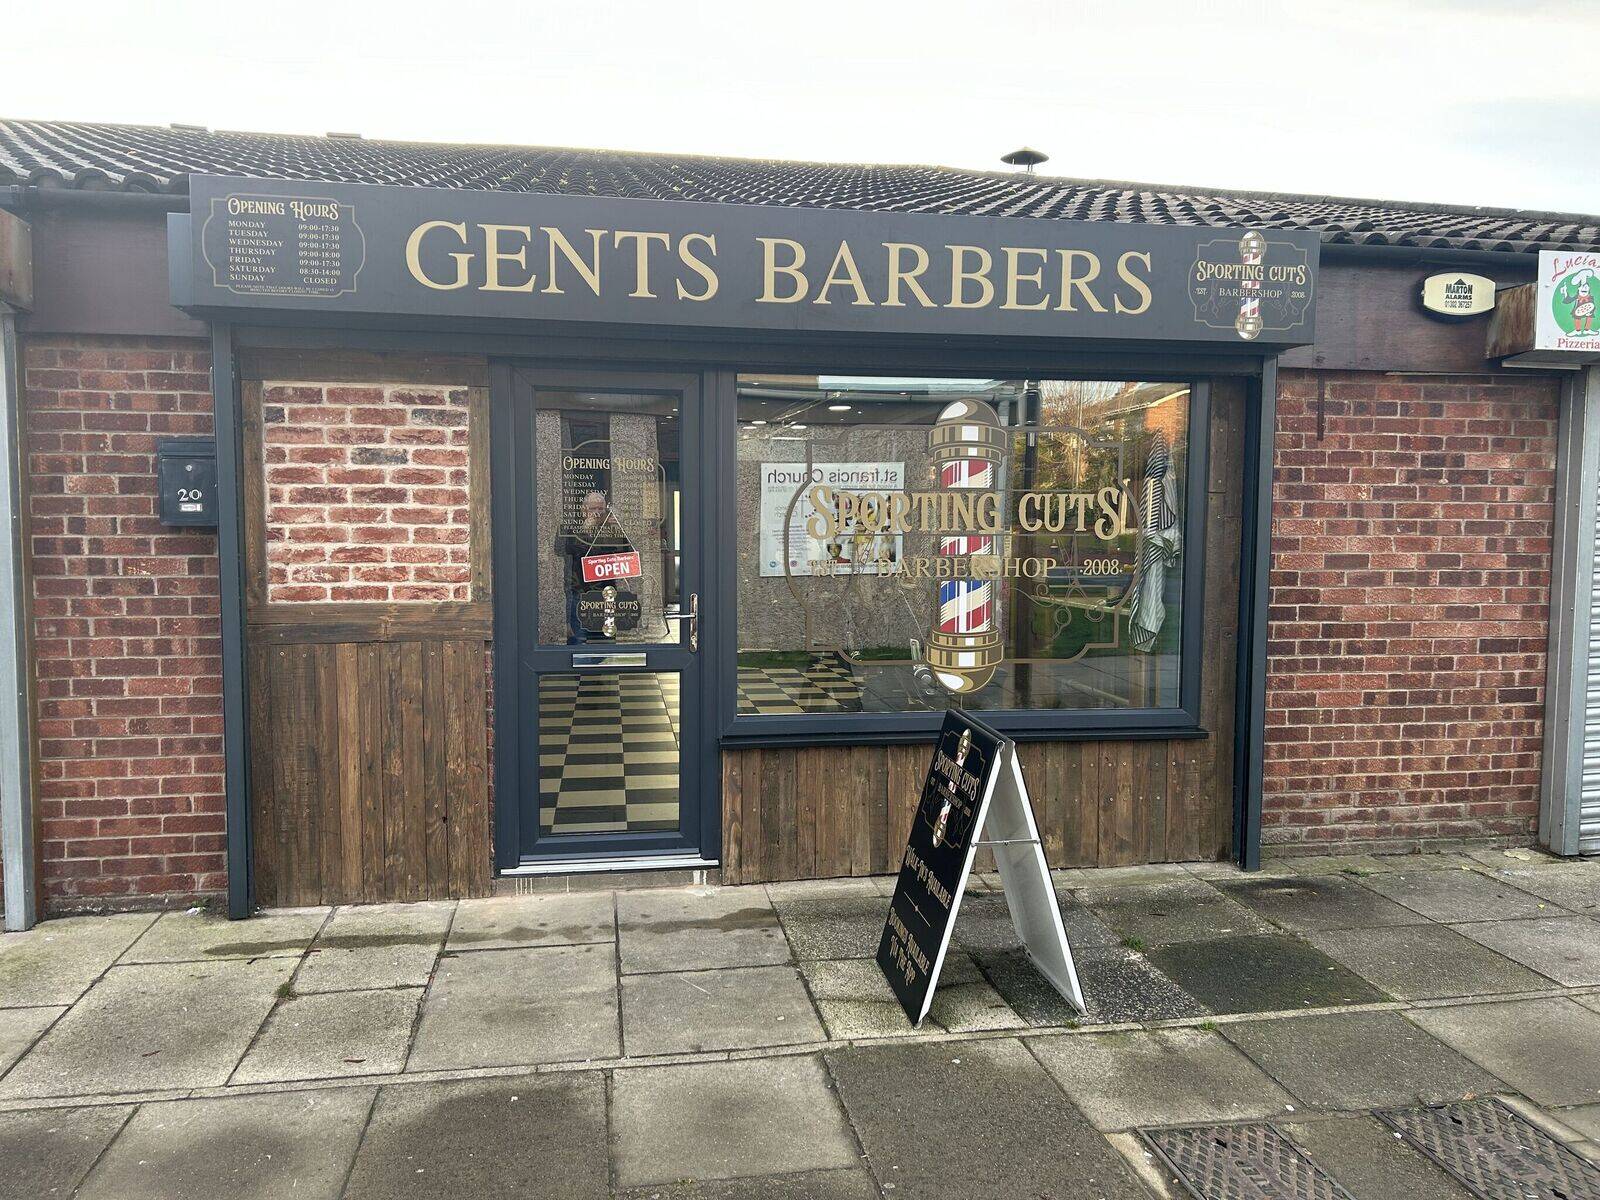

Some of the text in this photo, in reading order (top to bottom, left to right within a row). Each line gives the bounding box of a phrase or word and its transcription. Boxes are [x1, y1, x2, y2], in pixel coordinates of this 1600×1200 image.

[228, 197, 339, 221] OPENING HOURS
[228, 220, 266, 229] MONDAY
[229, 229, 269, 238] TUESDAY
[229, 238, 284, 248] WEDNESDAY
[229, 247, 276, 256] THURSDAY
[229, 256, 262, 264] FRIDAY
[229, 265, 276, 274] SATURDAY
[405, 220, 1153, 315] GENTS BARBERS
[1196, 260, 1306, 285] SPORTING CUTS
[1552, 255, 1600, 282] Lucia
[229, 274, 337, 285] SUNDAY CLOSED
[1220, 288, 1282, 298] BARBERSHOP
[1445, 284, 1473, 294] MARTON
[1557, 338, 1600, 350] Pizzeria
[563, 456, 610, 470] OPENING
[178, 488, 202, 502] 20
[806, 484, 1121, 541] SPORTING CUTS
[594, 562, 630, 577] OPEN
[878, 556, 1057, 578] BARBERSHOP
[1083, 558, 1120, 576] 2008
[580, 601, 638, 610] SPORTING CUTS
